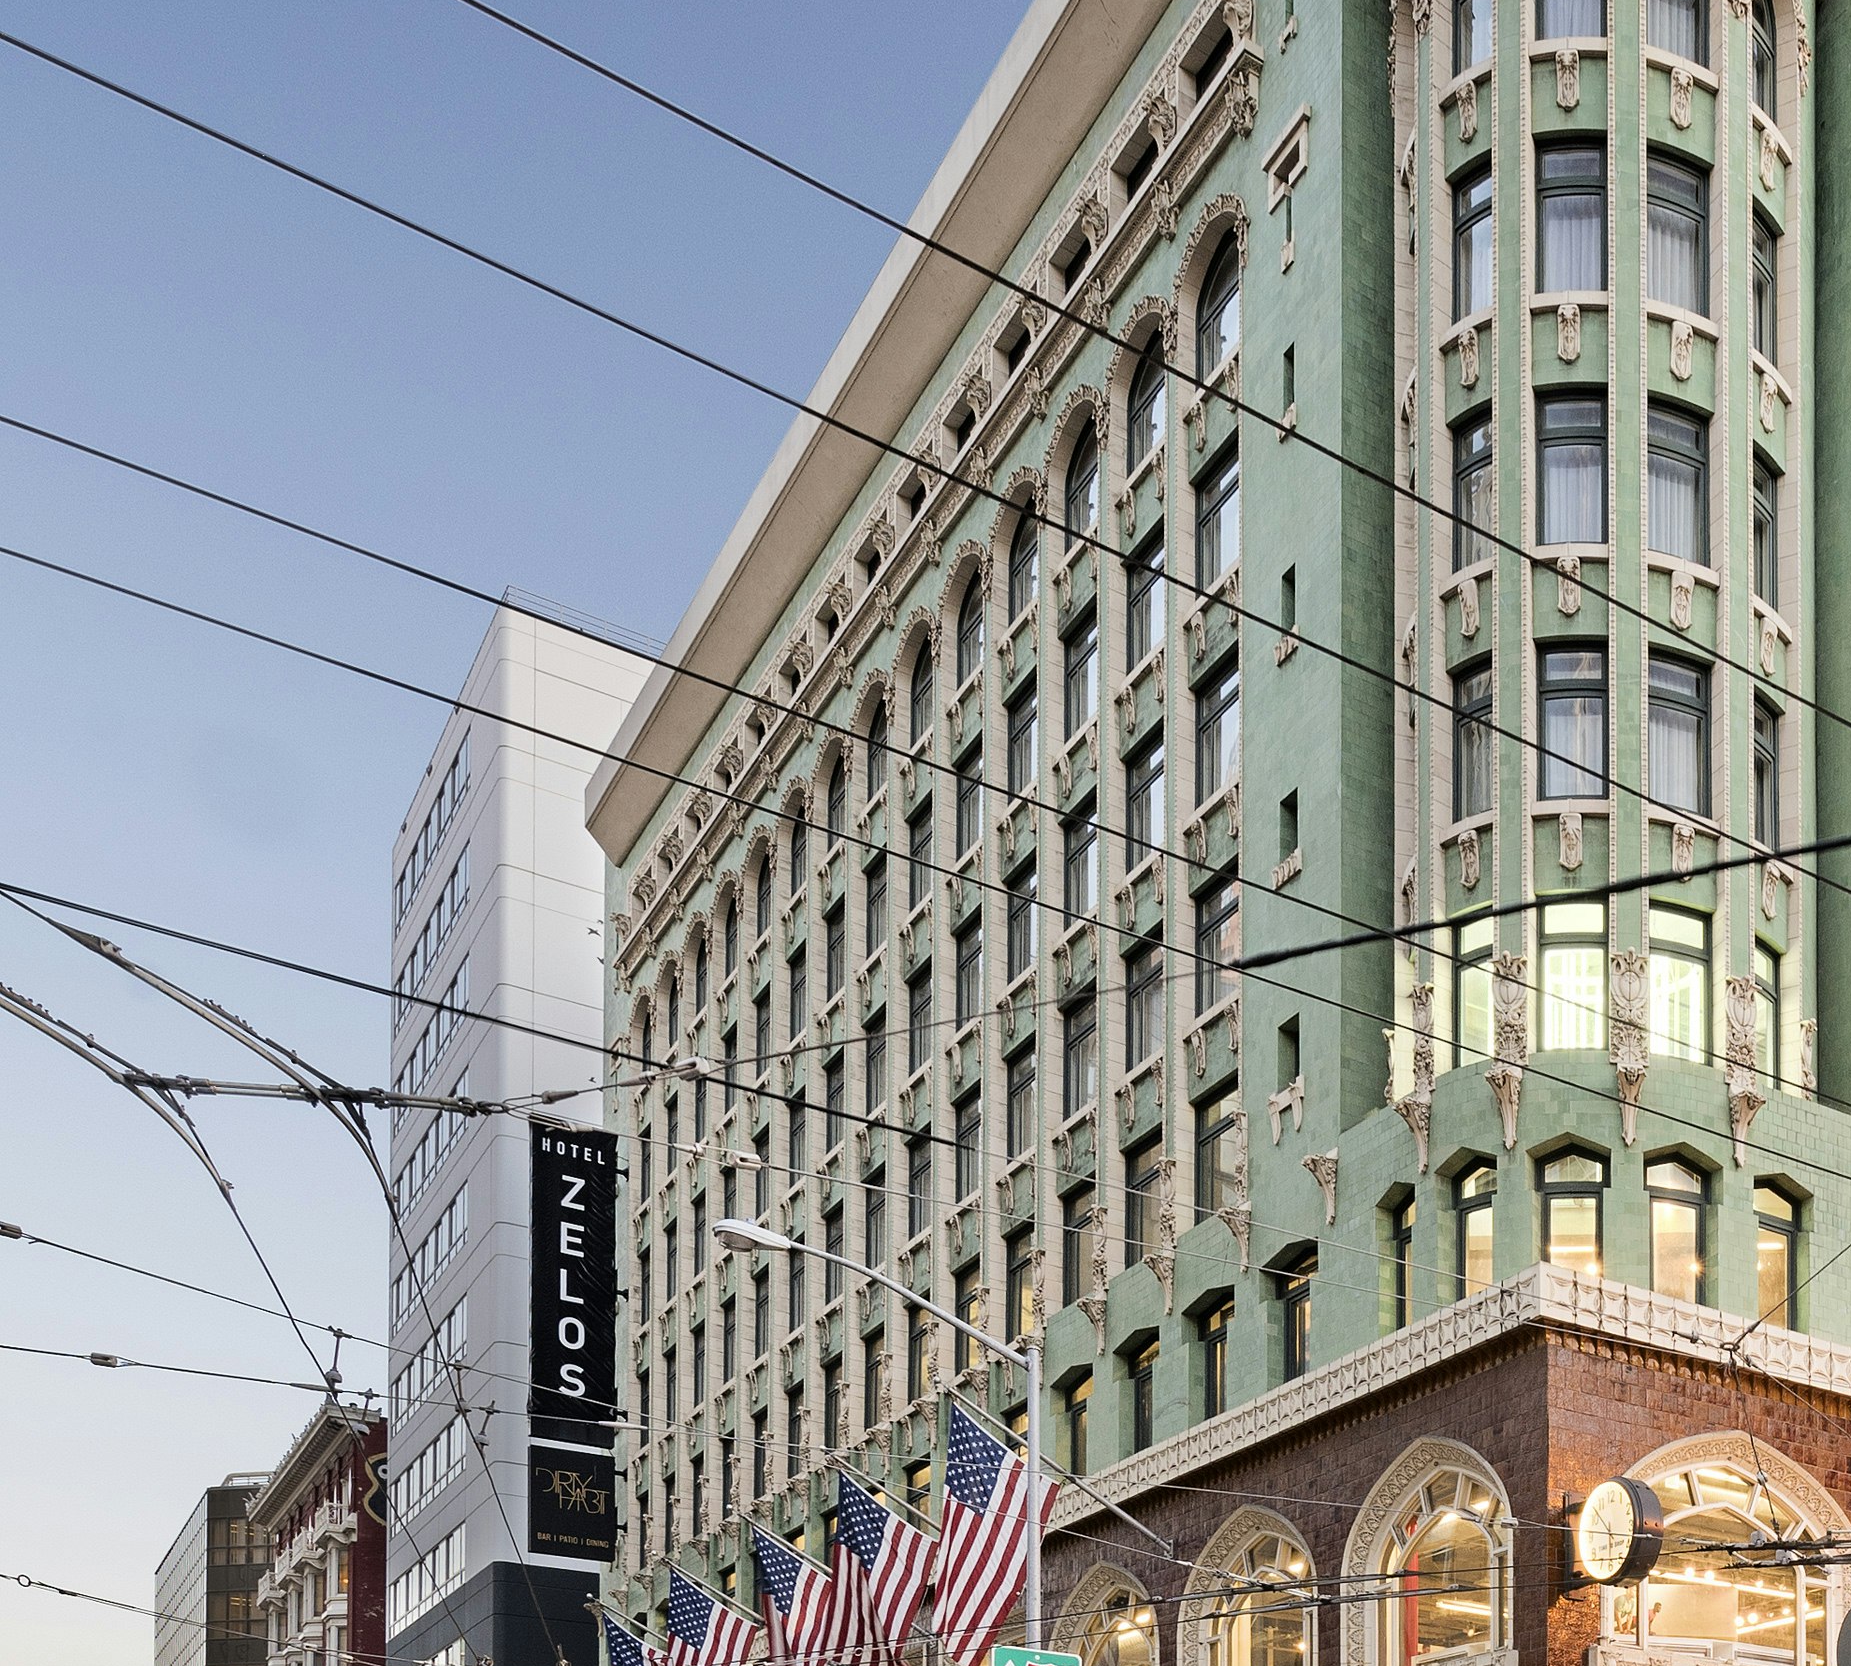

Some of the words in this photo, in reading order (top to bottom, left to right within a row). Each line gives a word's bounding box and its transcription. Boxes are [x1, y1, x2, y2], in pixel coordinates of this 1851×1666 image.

[542, 1137, 606, 1165] HOTEL
[558, 1174, 586, 1397] ZELOS
[537, 1531, 552, 1541] BAR
[559, 1534, 579, 1545] PATIO
